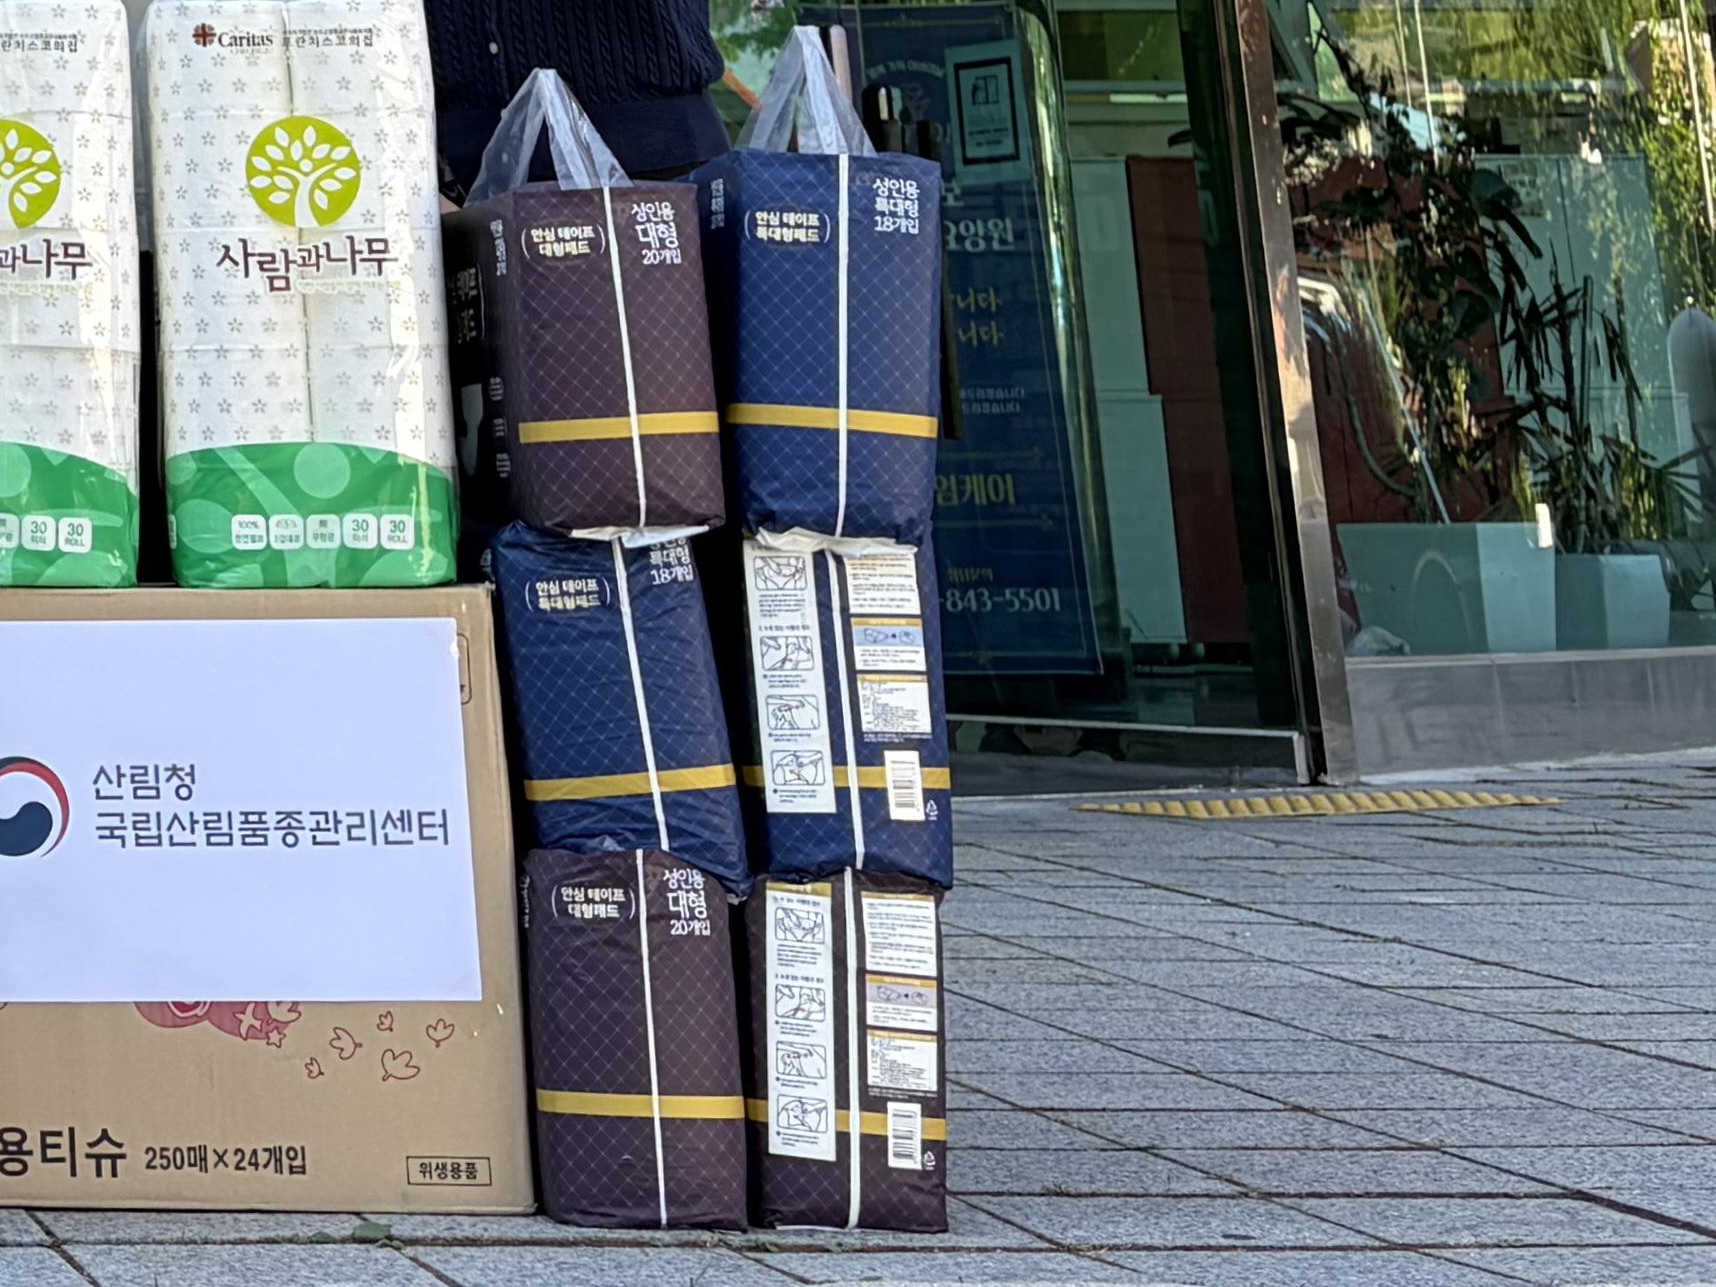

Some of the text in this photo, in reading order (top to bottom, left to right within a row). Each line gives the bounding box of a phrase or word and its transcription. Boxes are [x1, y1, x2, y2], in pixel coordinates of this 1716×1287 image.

[218, 31, 273, 48] Caritas
[873, 178, 920, 198] 성인용
[631, 202, 675, 222] 성인용
[874, 197, 919, 217] 특대형
[635, 222, 679, 248] 대형
[874, 216, 919, 234] 18개입
[217, 235, 399, 292] 사람과나무
[642, 249, 682, 265] 20개입
[30, 521, 47, 534] 30
[67, 523, 84, 536] 30
[352, 519, 369, 533] 30
[389, 520, 406, 533] 30
[650, 566, 694, 585] 18개입
[92, 763, 197, 802] 산림청
[95, 809, 450, 849] 국립산림품종관리센터
[663, 868, 705, 889] 성인용
[667, 890, 707, 918] 대형
[670, 919, 710, 936] 20개입
[418, 1161, 478, 1181] 위생용품
